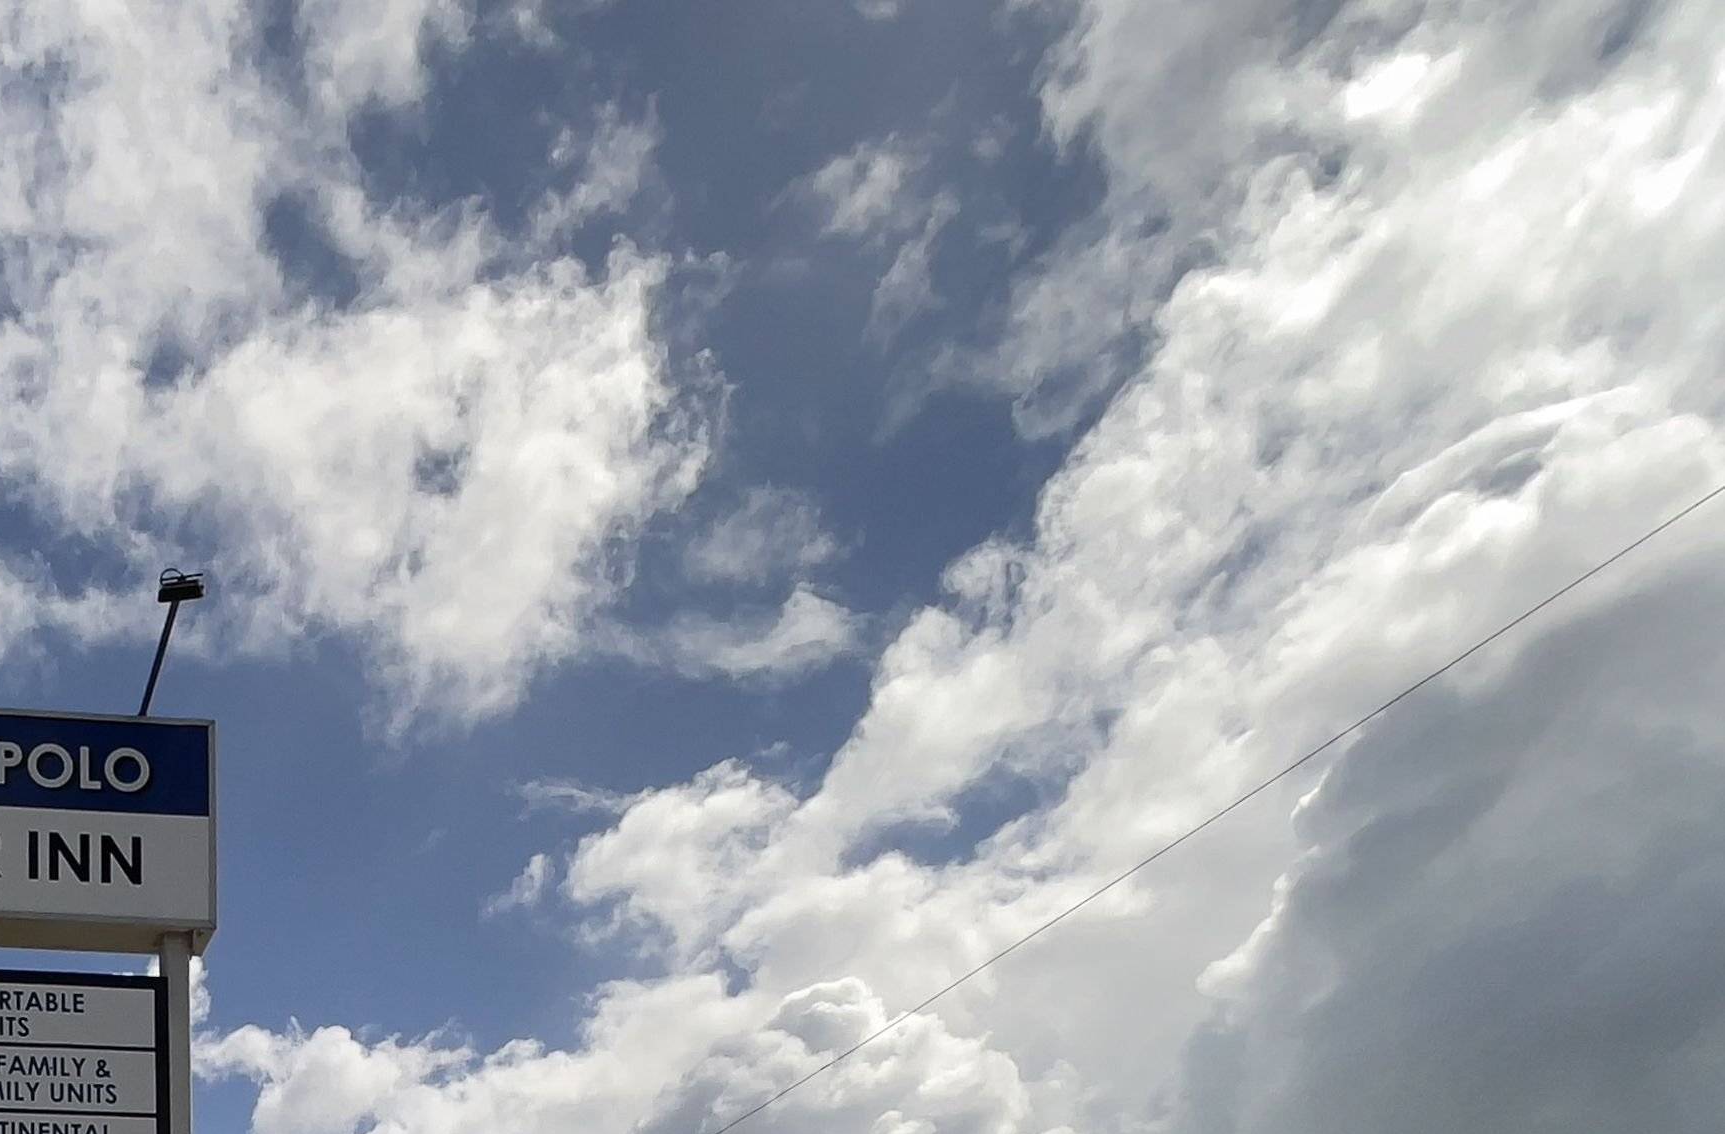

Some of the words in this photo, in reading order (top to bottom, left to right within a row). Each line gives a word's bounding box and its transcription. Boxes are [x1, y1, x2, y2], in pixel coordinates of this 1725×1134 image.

[28, 830, 143, 886] INN
[95, 1058, 111, 1078] &
[49, 1083, 117, 1104] UNITS
